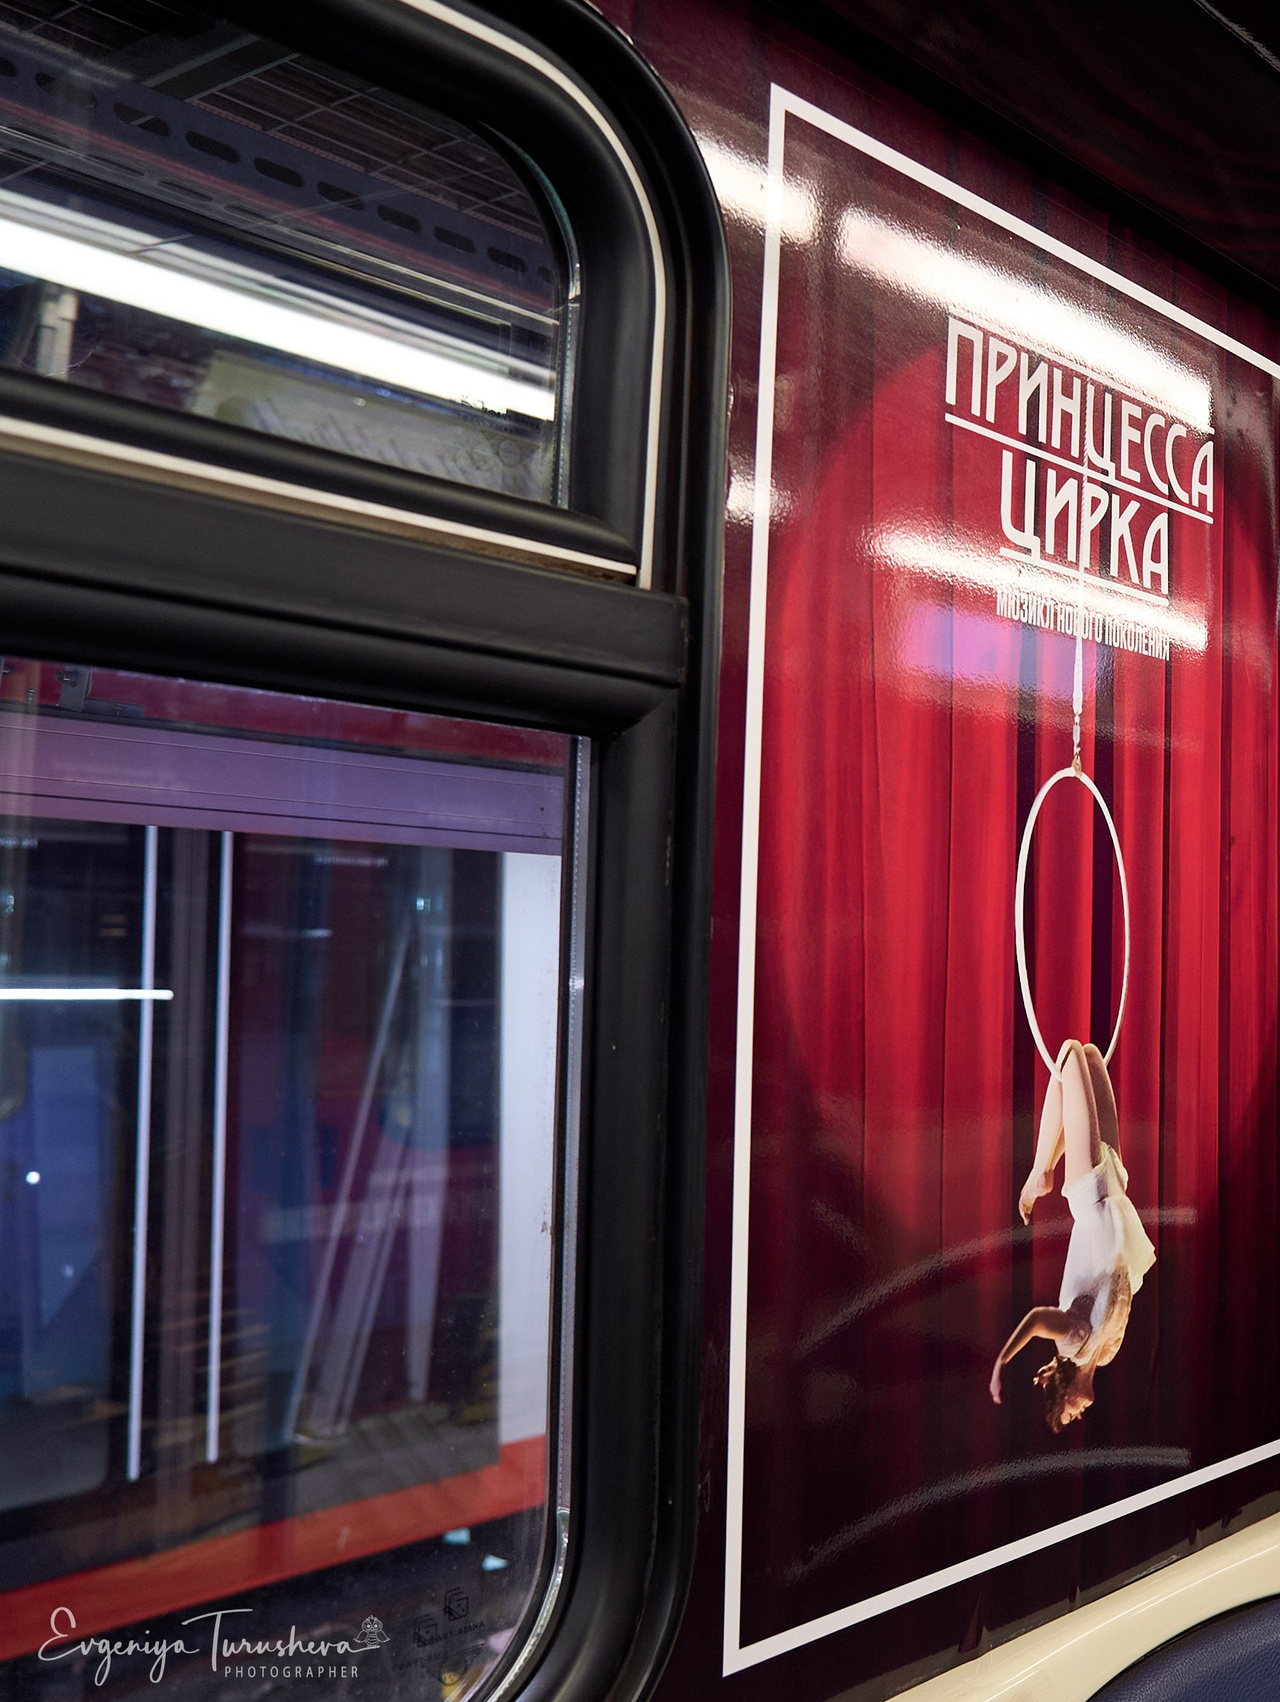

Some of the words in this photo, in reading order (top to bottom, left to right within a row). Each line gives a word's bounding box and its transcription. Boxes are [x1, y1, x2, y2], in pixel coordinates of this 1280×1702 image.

[945, 316, 1214, 513] ПРИНЦЕССА
[1000, 448, 1169, 595] ЦИРКА
[996, 588, 1054, 630] МЮЗИКЛ
[1104, 615, 1170, 661] ПОКОЛЕНИЯ
